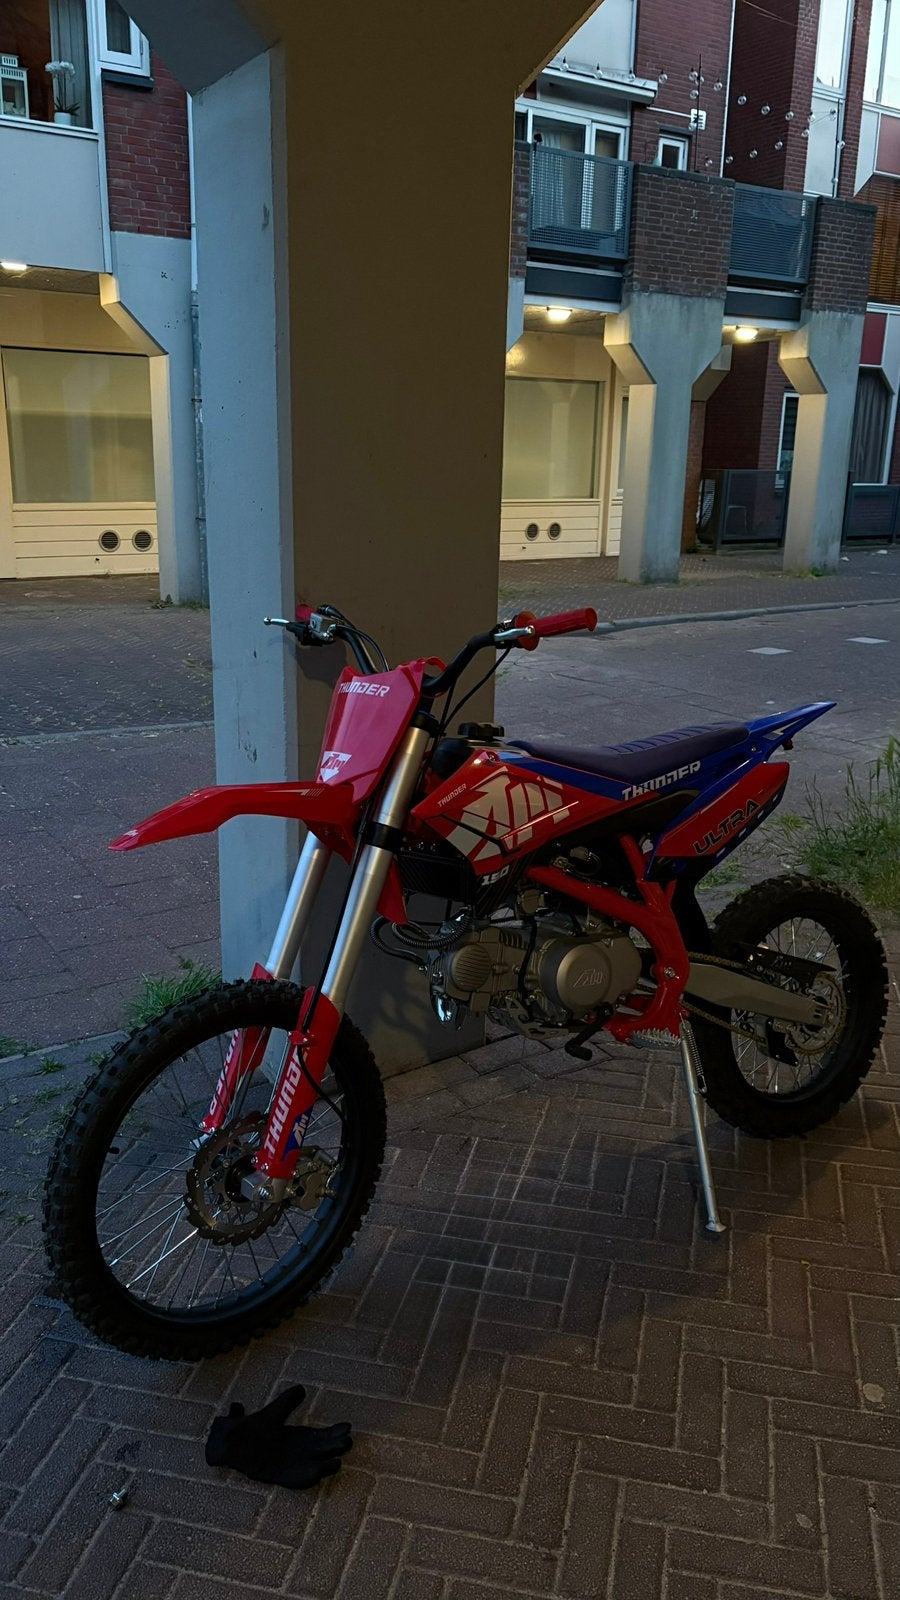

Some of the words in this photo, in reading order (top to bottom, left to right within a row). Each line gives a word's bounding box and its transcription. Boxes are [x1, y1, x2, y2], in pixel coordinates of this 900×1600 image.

[338, 681, 390, 697] THUNDER
[437, 783, 466, 807] THUNDER
[693, 799, 760, 854] ULTRA
